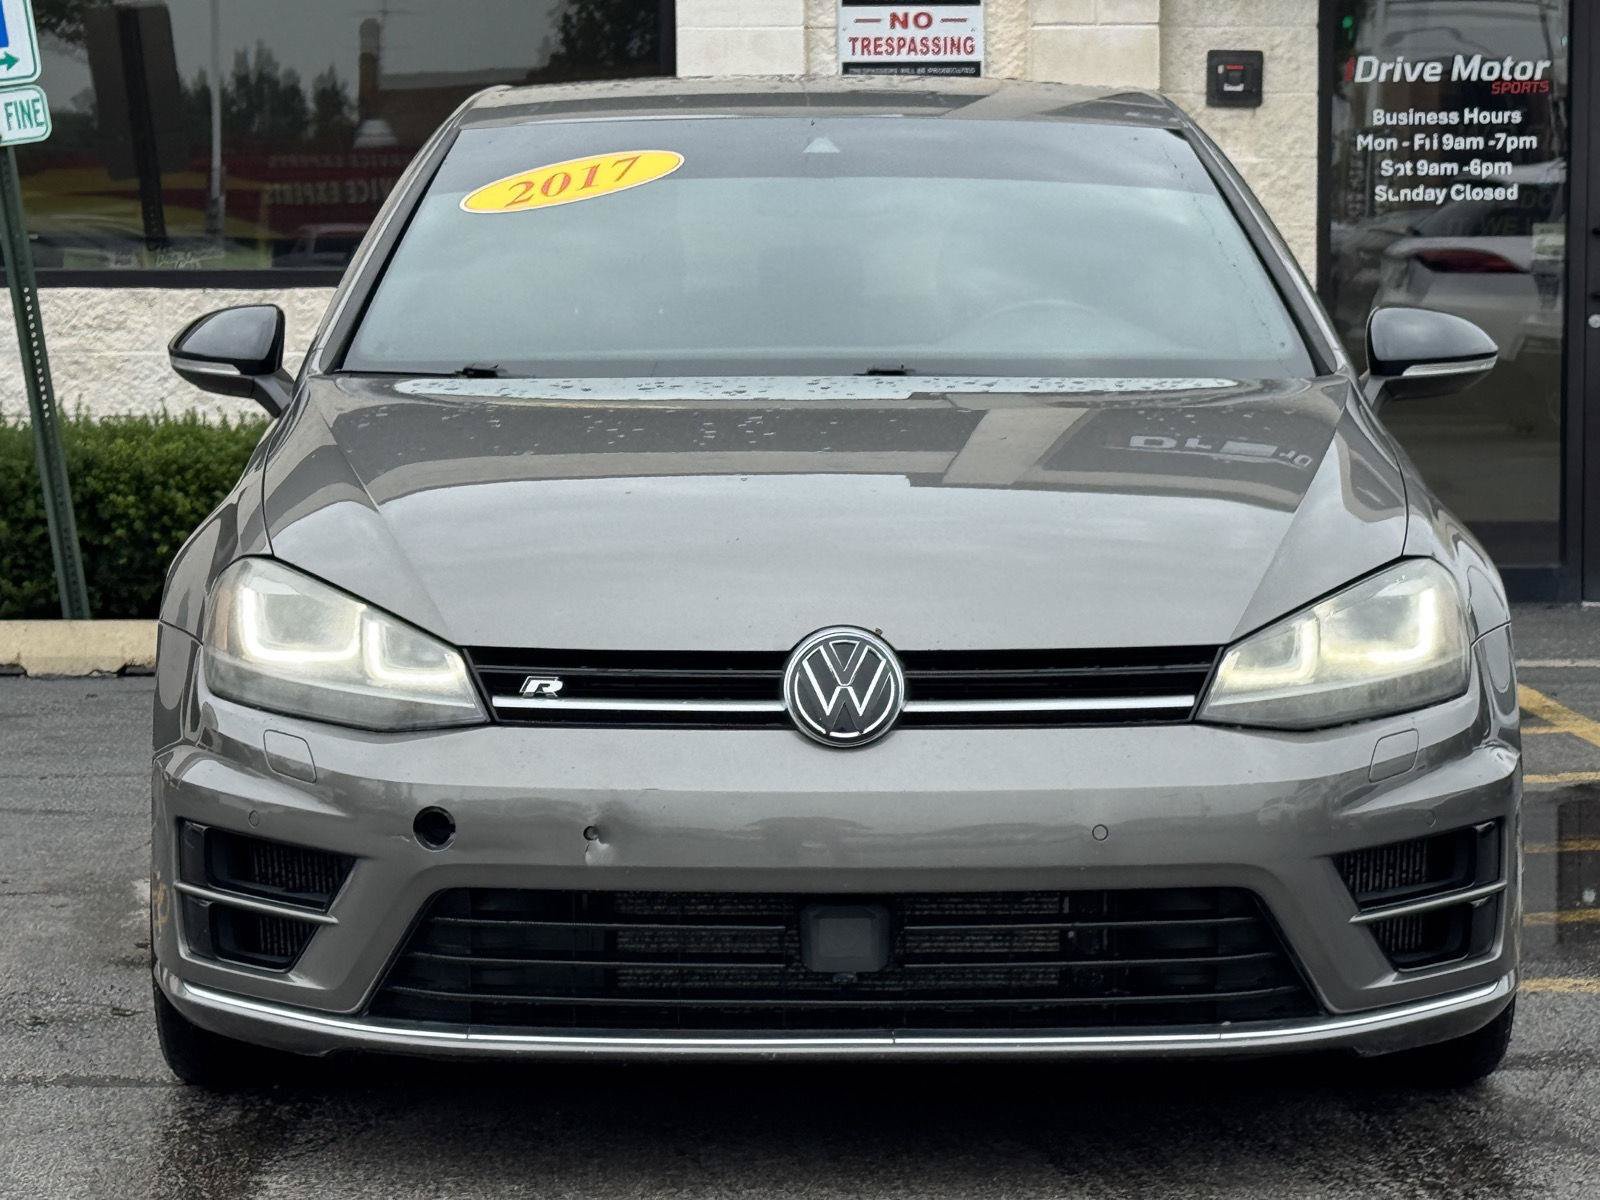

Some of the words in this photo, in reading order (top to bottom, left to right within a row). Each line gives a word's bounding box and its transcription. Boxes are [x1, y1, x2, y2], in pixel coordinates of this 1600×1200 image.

[889, 12, 933, 29] NO
[848, 36, 976, 56] TRESPASSING
[1451, 54, 1551, 83] Motor
[1491, 81, 1549, 95] SPORTS
[4, 98, 45, 131] FINE
[1372, 108, 1460, 126] Business
[1463, 108, 1522, 125] Hours
[1356, 134, 1398, 151] Mon
[1442, 133, 1484, 151] 9am
[1416, 159, 1458, 176] 9am
[504, 155, 642, 208] 2017
[1450, 183, 1519, 201] Closed
[519, 675, 563, 698] R
